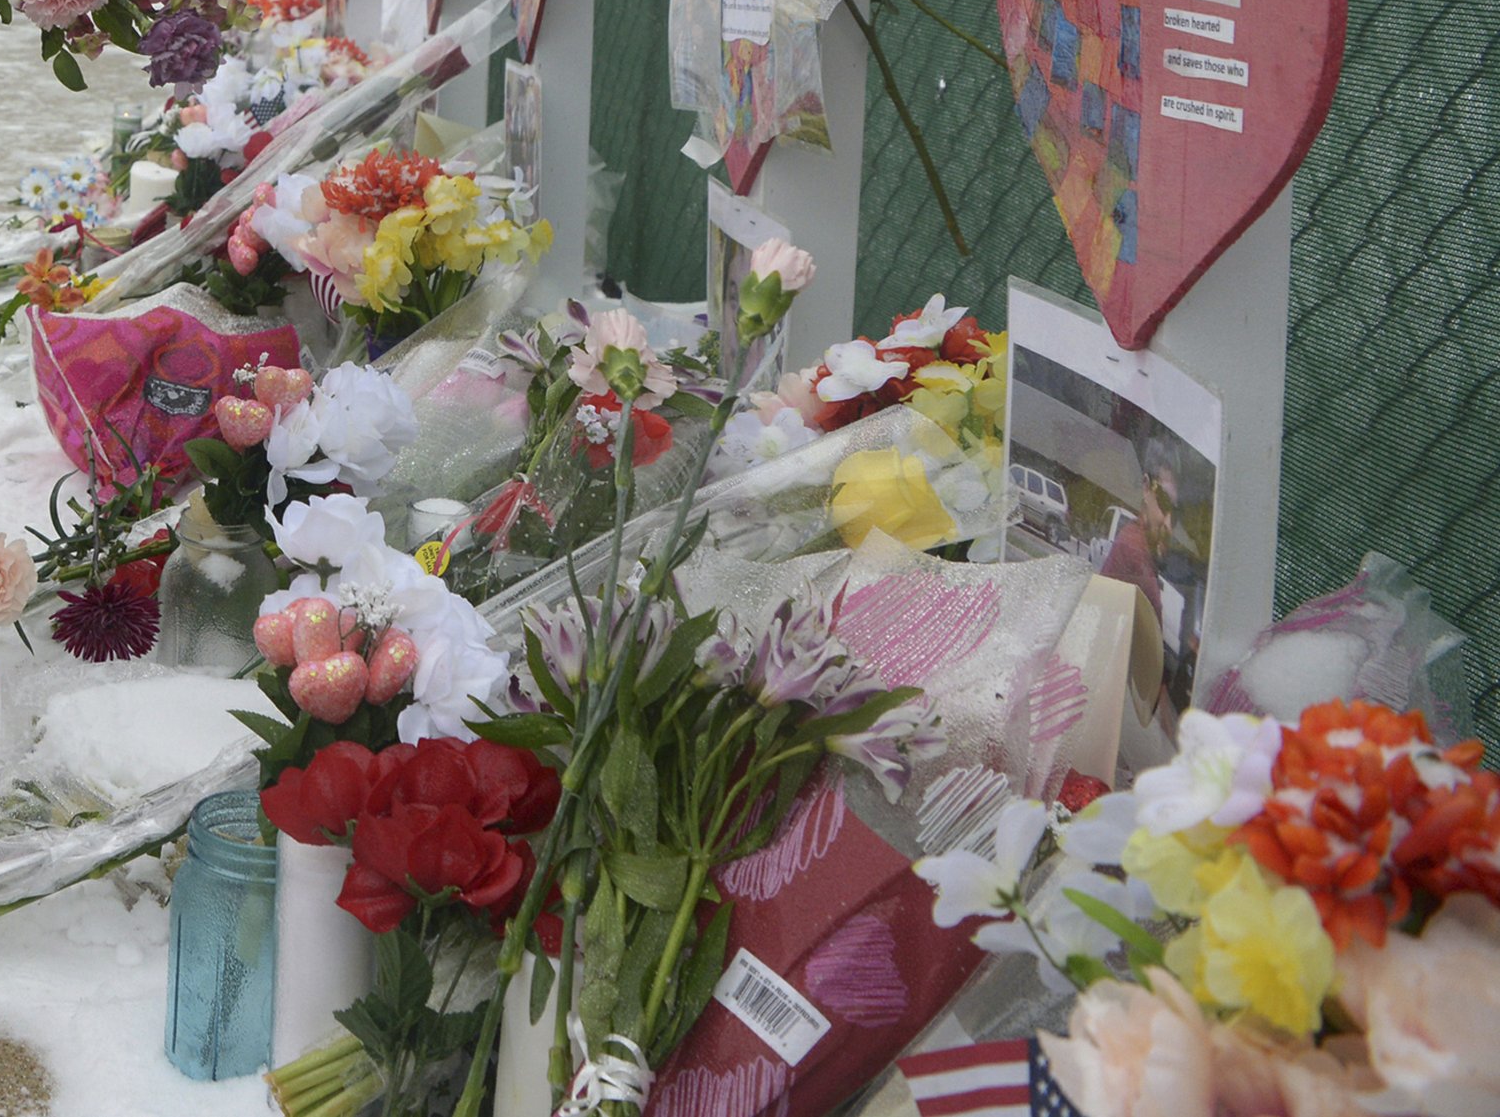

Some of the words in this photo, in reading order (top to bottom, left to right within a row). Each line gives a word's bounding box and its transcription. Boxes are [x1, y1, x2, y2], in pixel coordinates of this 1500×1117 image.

[1164, 13, 1190, 28] broken
[1191, 16, 1221, 33] hearted
[1167, 53, 1182, 66] and
[1182, 57, 1203, 70] saves
[1204, 59, 1226, 74] those
[1227, 63, 1245, 77] who
[1163, 97, 1175, 109] are
[1175, 100, 1205, 116] crushed
[1206, 104, 1214, 117] in
[1215, 107, 1237, 123] spirit.
